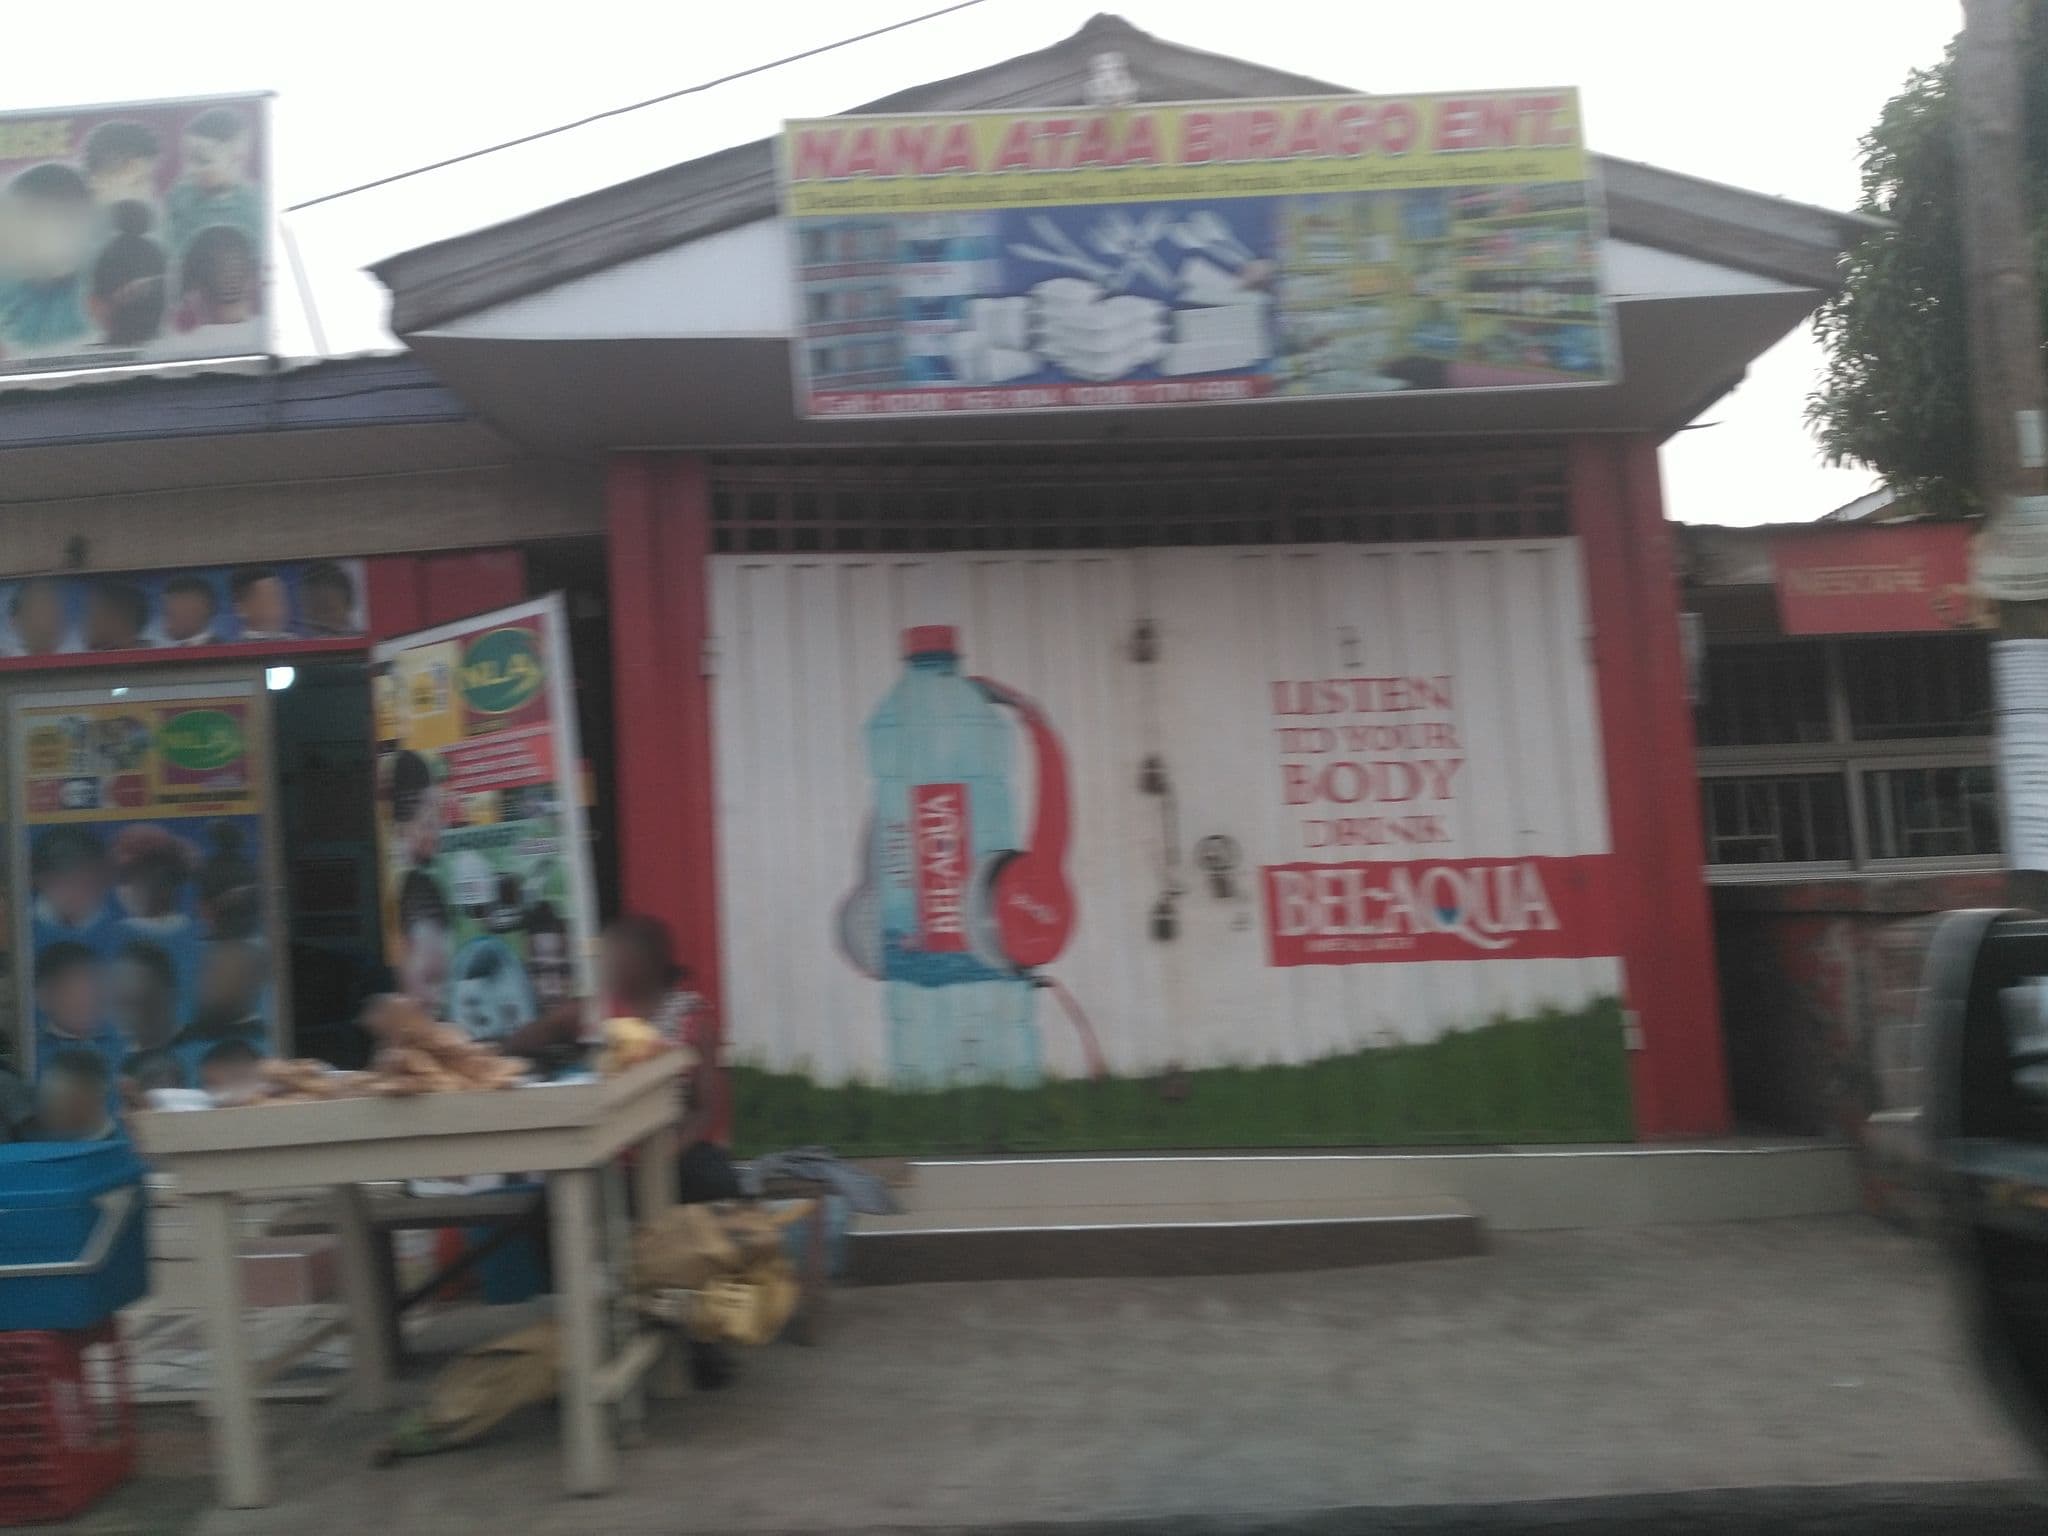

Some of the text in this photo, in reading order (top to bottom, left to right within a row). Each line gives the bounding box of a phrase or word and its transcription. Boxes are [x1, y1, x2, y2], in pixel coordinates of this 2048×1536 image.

[990, 113, 1163, 173] ATAA
[1182, 103, 1419, 166] BIRAGO
[1270, 675, 1455, 715] LISTEN
[1273, 723, 1463, 753] TO YOUR
[1280, 758, 1465, 806] BODY
[1302, 815, 1454, 848] DRINK
